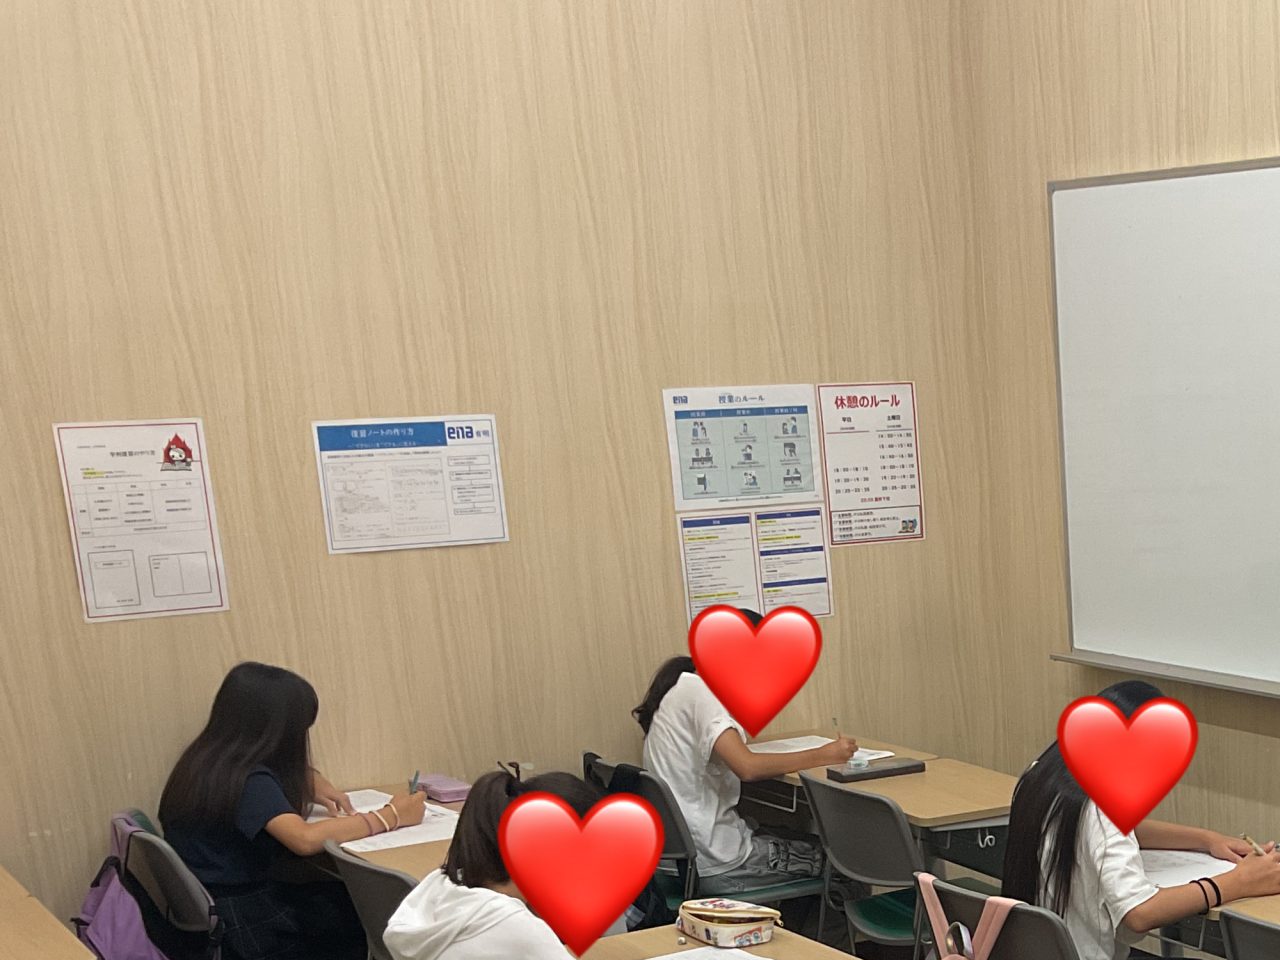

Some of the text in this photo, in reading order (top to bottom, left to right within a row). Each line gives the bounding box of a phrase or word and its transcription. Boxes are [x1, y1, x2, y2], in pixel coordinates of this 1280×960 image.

[834, 394, 901, 409] 休憩のルール
[447, 426, 474, 439] ena
